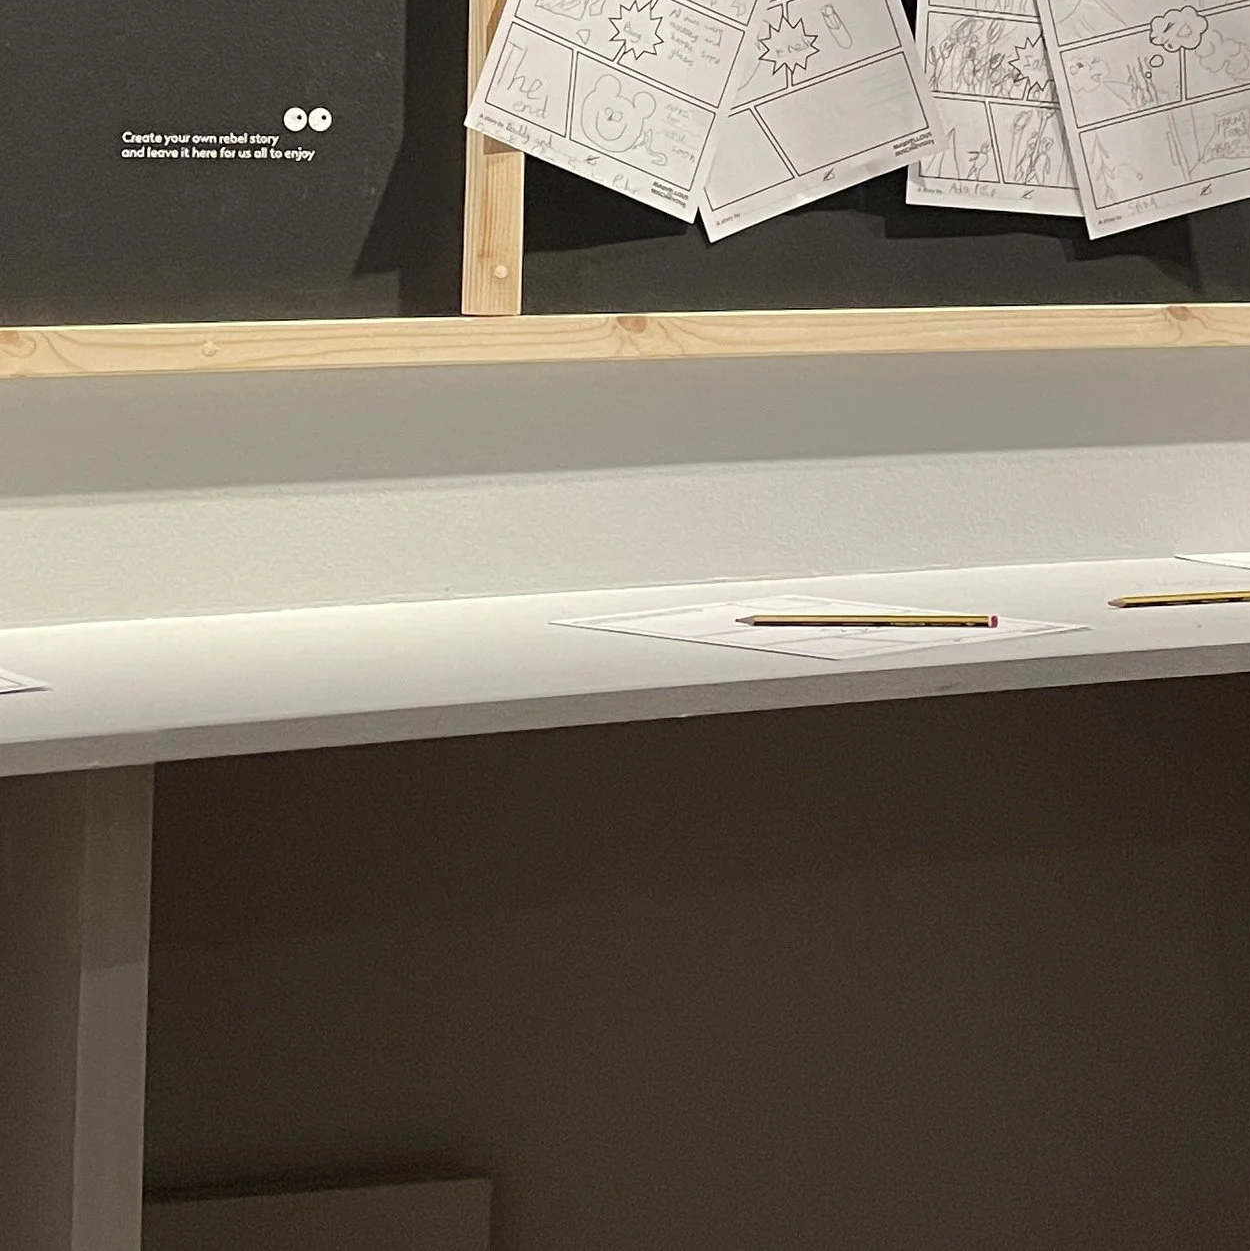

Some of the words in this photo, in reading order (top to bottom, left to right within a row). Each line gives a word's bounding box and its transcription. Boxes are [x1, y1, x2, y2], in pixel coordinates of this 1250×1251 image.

[497, 40, 543, 100] The
[121, 131, 162, 145] Create
[164, 134, 190, 147] your
[192, 134, 217, 145] own
[219, 132, 248, 145] rebel
[249, 134, 280, 147] story
[121, 147, 145, 159] and
[147, 147, 179, 159] leave
[180, 147, 190, 159] it
[192, 147, 217, 159] here
[219, 147, 236, 159] for
[238, 149, 252, 159] us
[253, 147, 268, 159] all
[269, 148, 283, 159] to
[284, 148, 316, 162] enjoy
